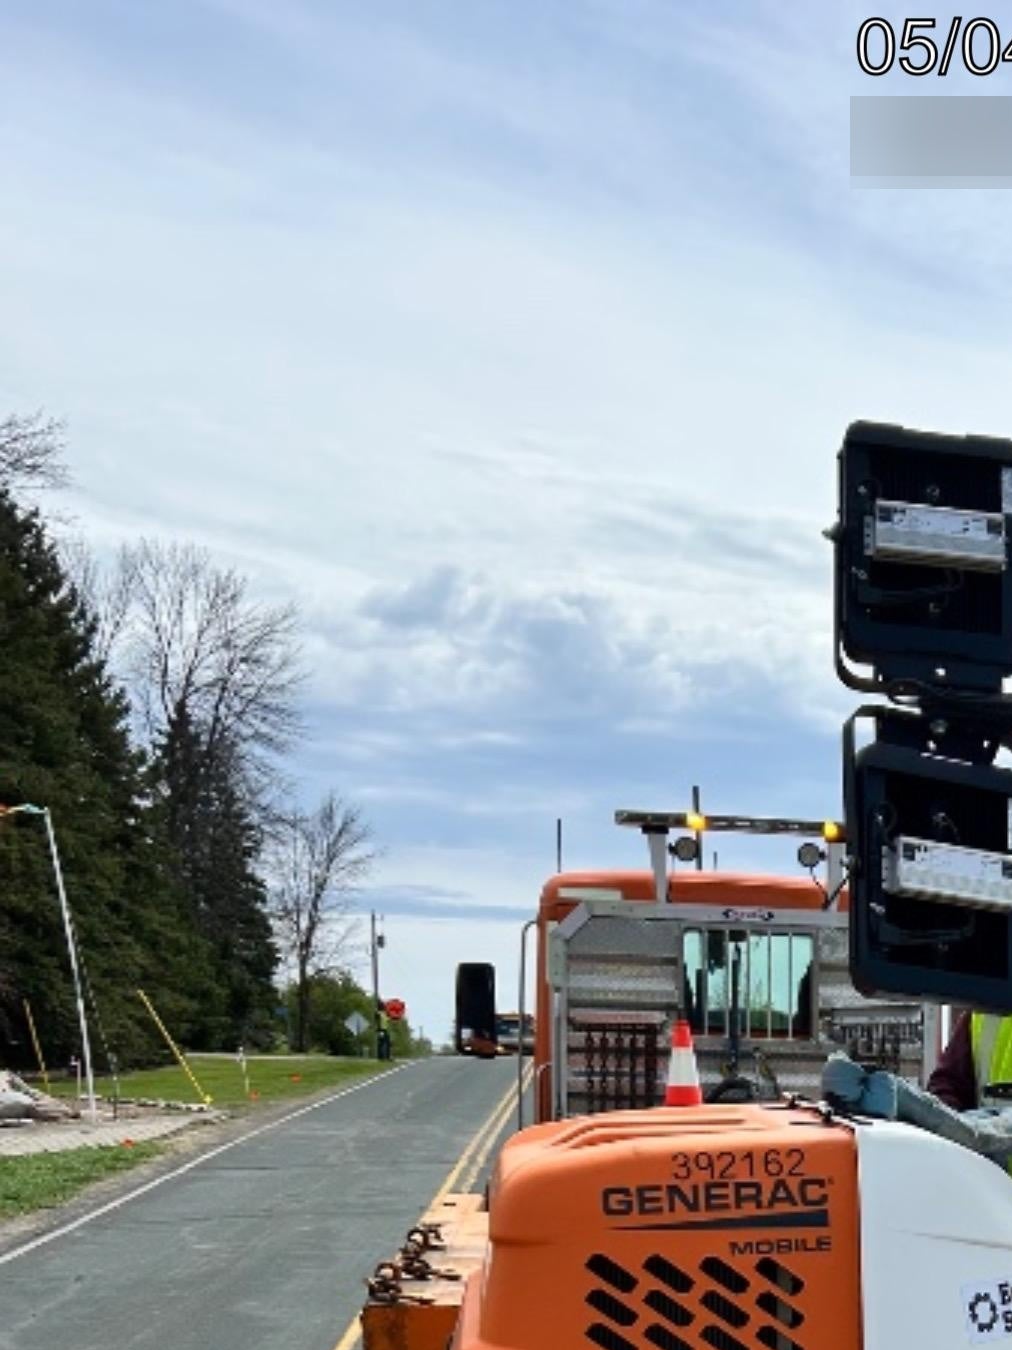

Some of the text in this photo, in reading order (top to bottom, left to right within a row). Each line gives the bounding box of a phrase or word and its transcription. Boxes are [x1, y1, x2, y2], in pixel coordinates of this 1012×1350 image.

[671, 1149, 805, 1180] 392162
[602, 1178, 829, 1215] GENERAC
[728, 1236, 832, 1256] MOBILE
